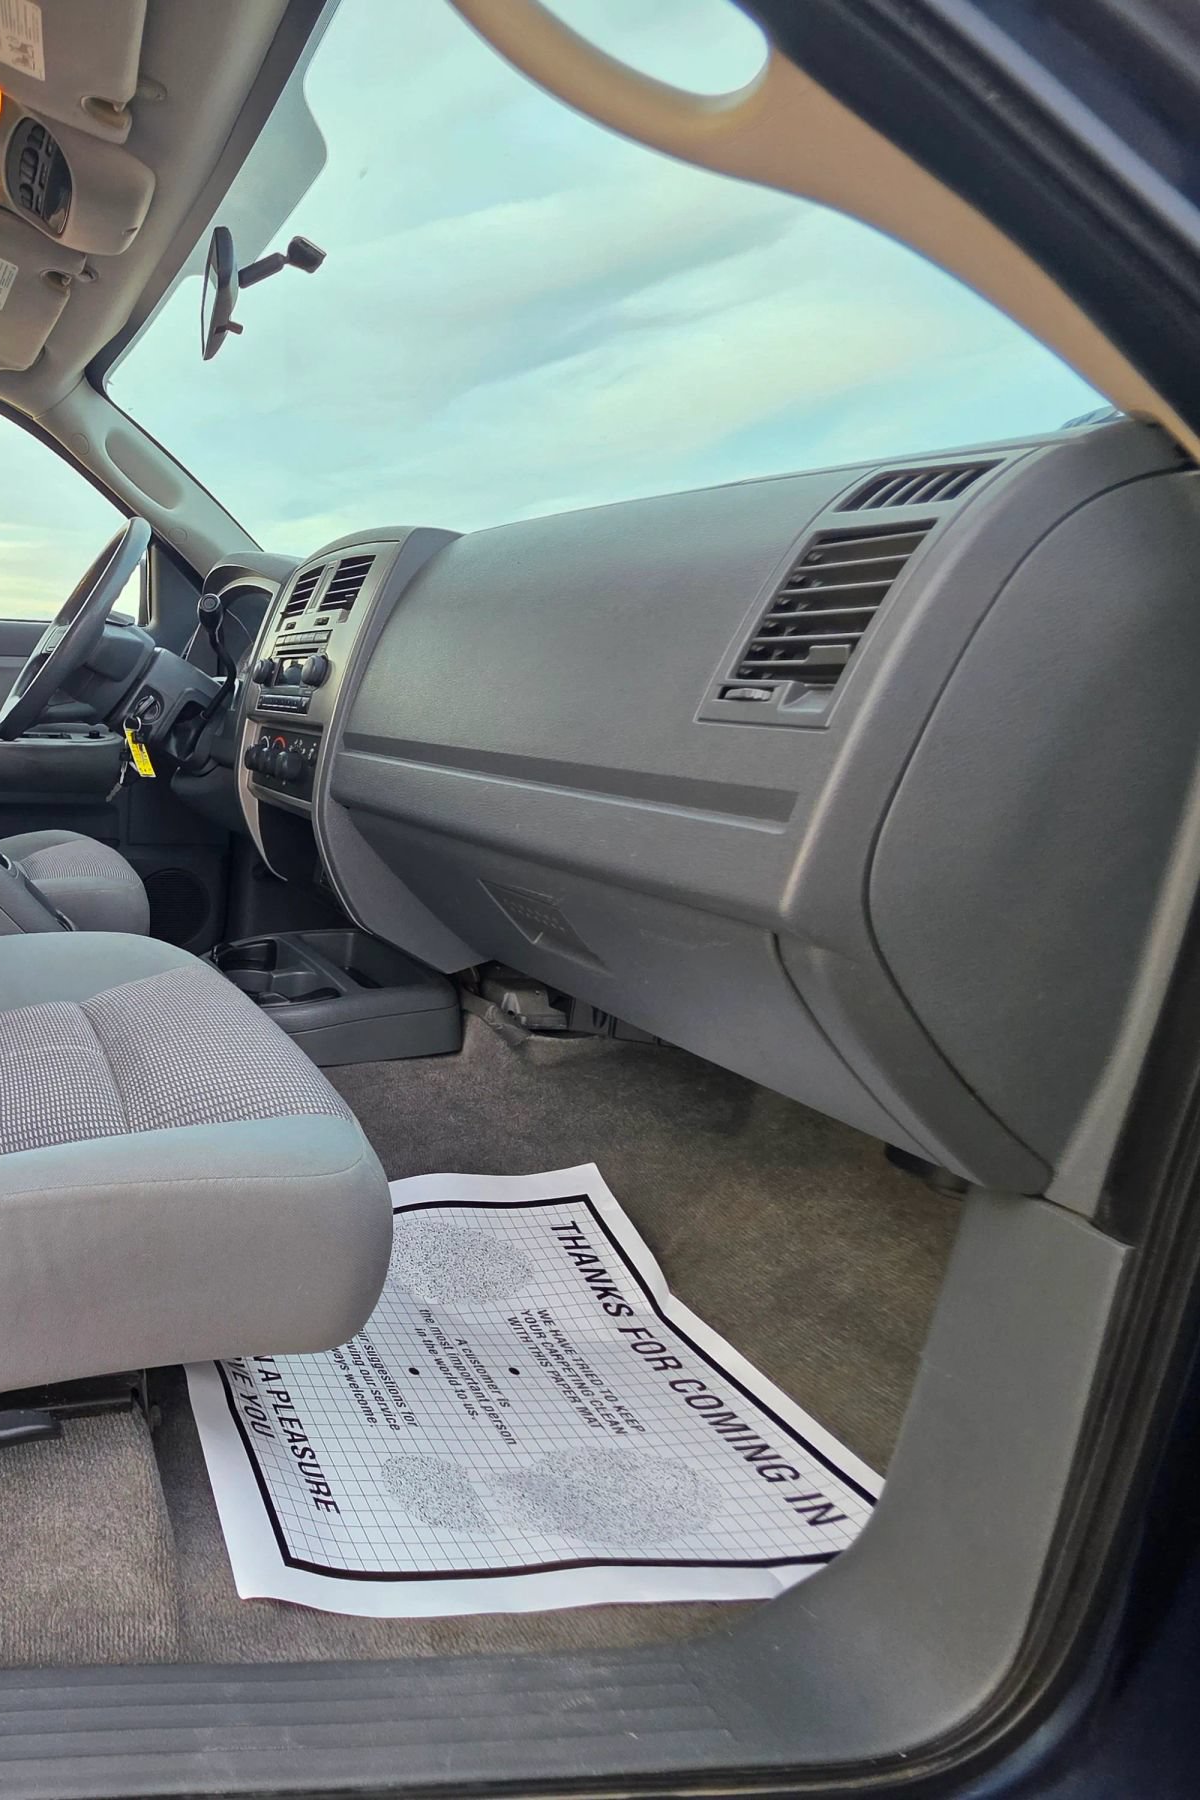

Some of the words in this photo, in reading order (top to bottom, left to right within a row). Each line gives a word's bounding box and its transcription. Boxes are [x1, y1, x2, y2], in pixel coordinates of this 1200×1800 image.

[240, 1392, 276, 1439] YOU
[258, 1369, 282, 1382] A
[345, 1373, 378, 1428] welcome.
[346, 1340, 365, 1366] ving
[360, 1369, 377, 1387] our
[371, 1389, 401, 1431] service
[364, 1344, 407, 1408] suggestions
[401, 1411, 419, 1427] for
[414, 1327, 427, 1337] in
[422, 1339, 438, 1356] the
[434, 1357, 462, 1386] world
[454, 1388, 468, 1400] to
[463, 1403, 479, 1420] us.
[419, 1309, 435, 1324] the
[431, 1326, 454, 1350] most
[449, 1352, 490, 1402] important
[480, 1405, 517, 1446] person
[455, 1338, 468, 1346] A
[462, 1348, 502, 1394] customer
[497, 1395, 511, 1408] is
[507, 1316, 533, 1343] WITH
[528, 1345, 553, 1368] THIS
[547, 1369, 582, 1404] PAPER
[575, 1406, 605, 1430] MAT
[520, 1309, 547, 1339] YOUR
[541, 1341, 595, 1397] CARPETING
[590, 1400, 628, 1434] CLEAN
[537, 1310, 557, 1327] WE
[550, 1329, 577, 1355] HAVE
[572, 1357, 604, 1386] TRIED
[600, 1388, 619, 1402] TO
[613, 1405, 646, 1433] KEEP
[551, 1220, 634, 1317] THANKS
[617, 1328, 683, 1371] FOR
[669, 1379, 800, 1483] COMING
[783, 1493, 849, 1527] IN
[266, 1390, 341, 1515] PLEASURE
